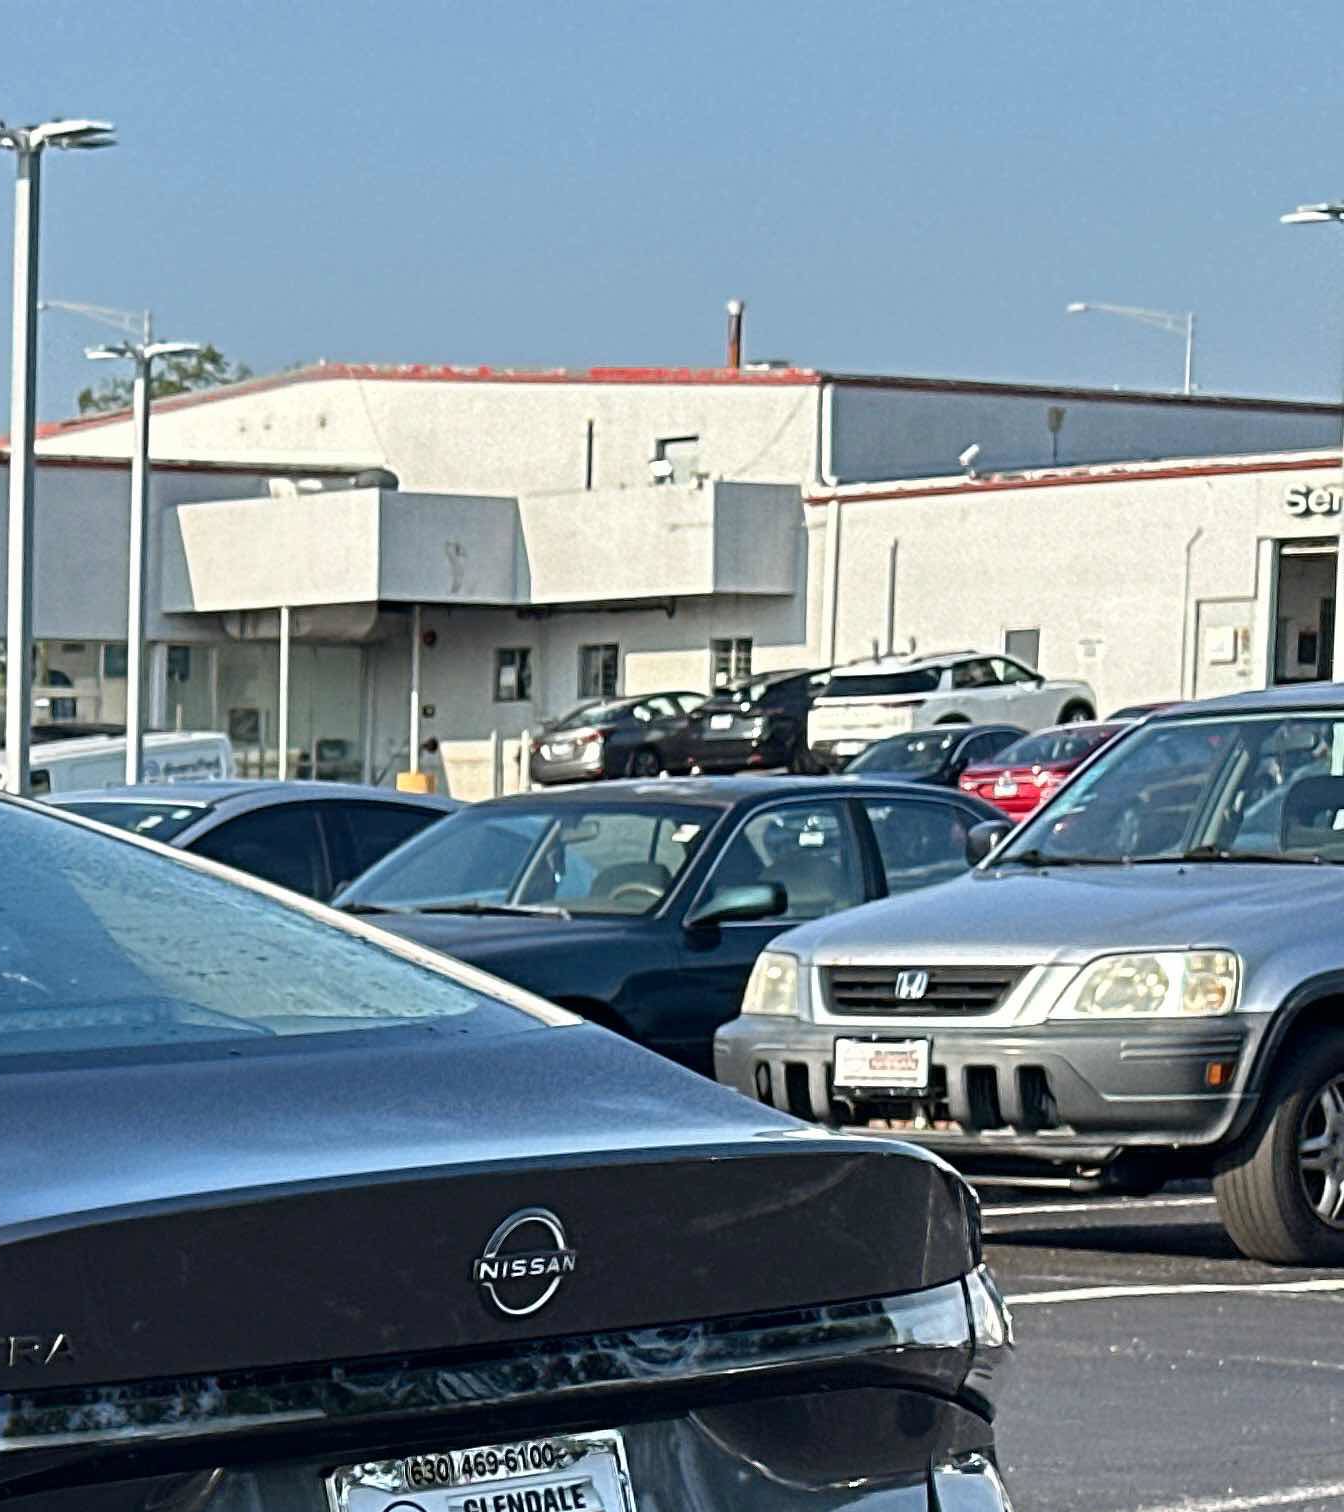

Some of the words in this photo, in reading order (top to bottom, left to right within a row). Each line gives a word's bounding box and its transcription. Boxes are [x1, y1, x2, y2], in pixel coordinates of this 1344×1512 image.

[478, 1254, 577, 1280] NISSAN
[404, 1451, 456, 1487] (630)
[461, 1442, 555, 1478] 469-6100
